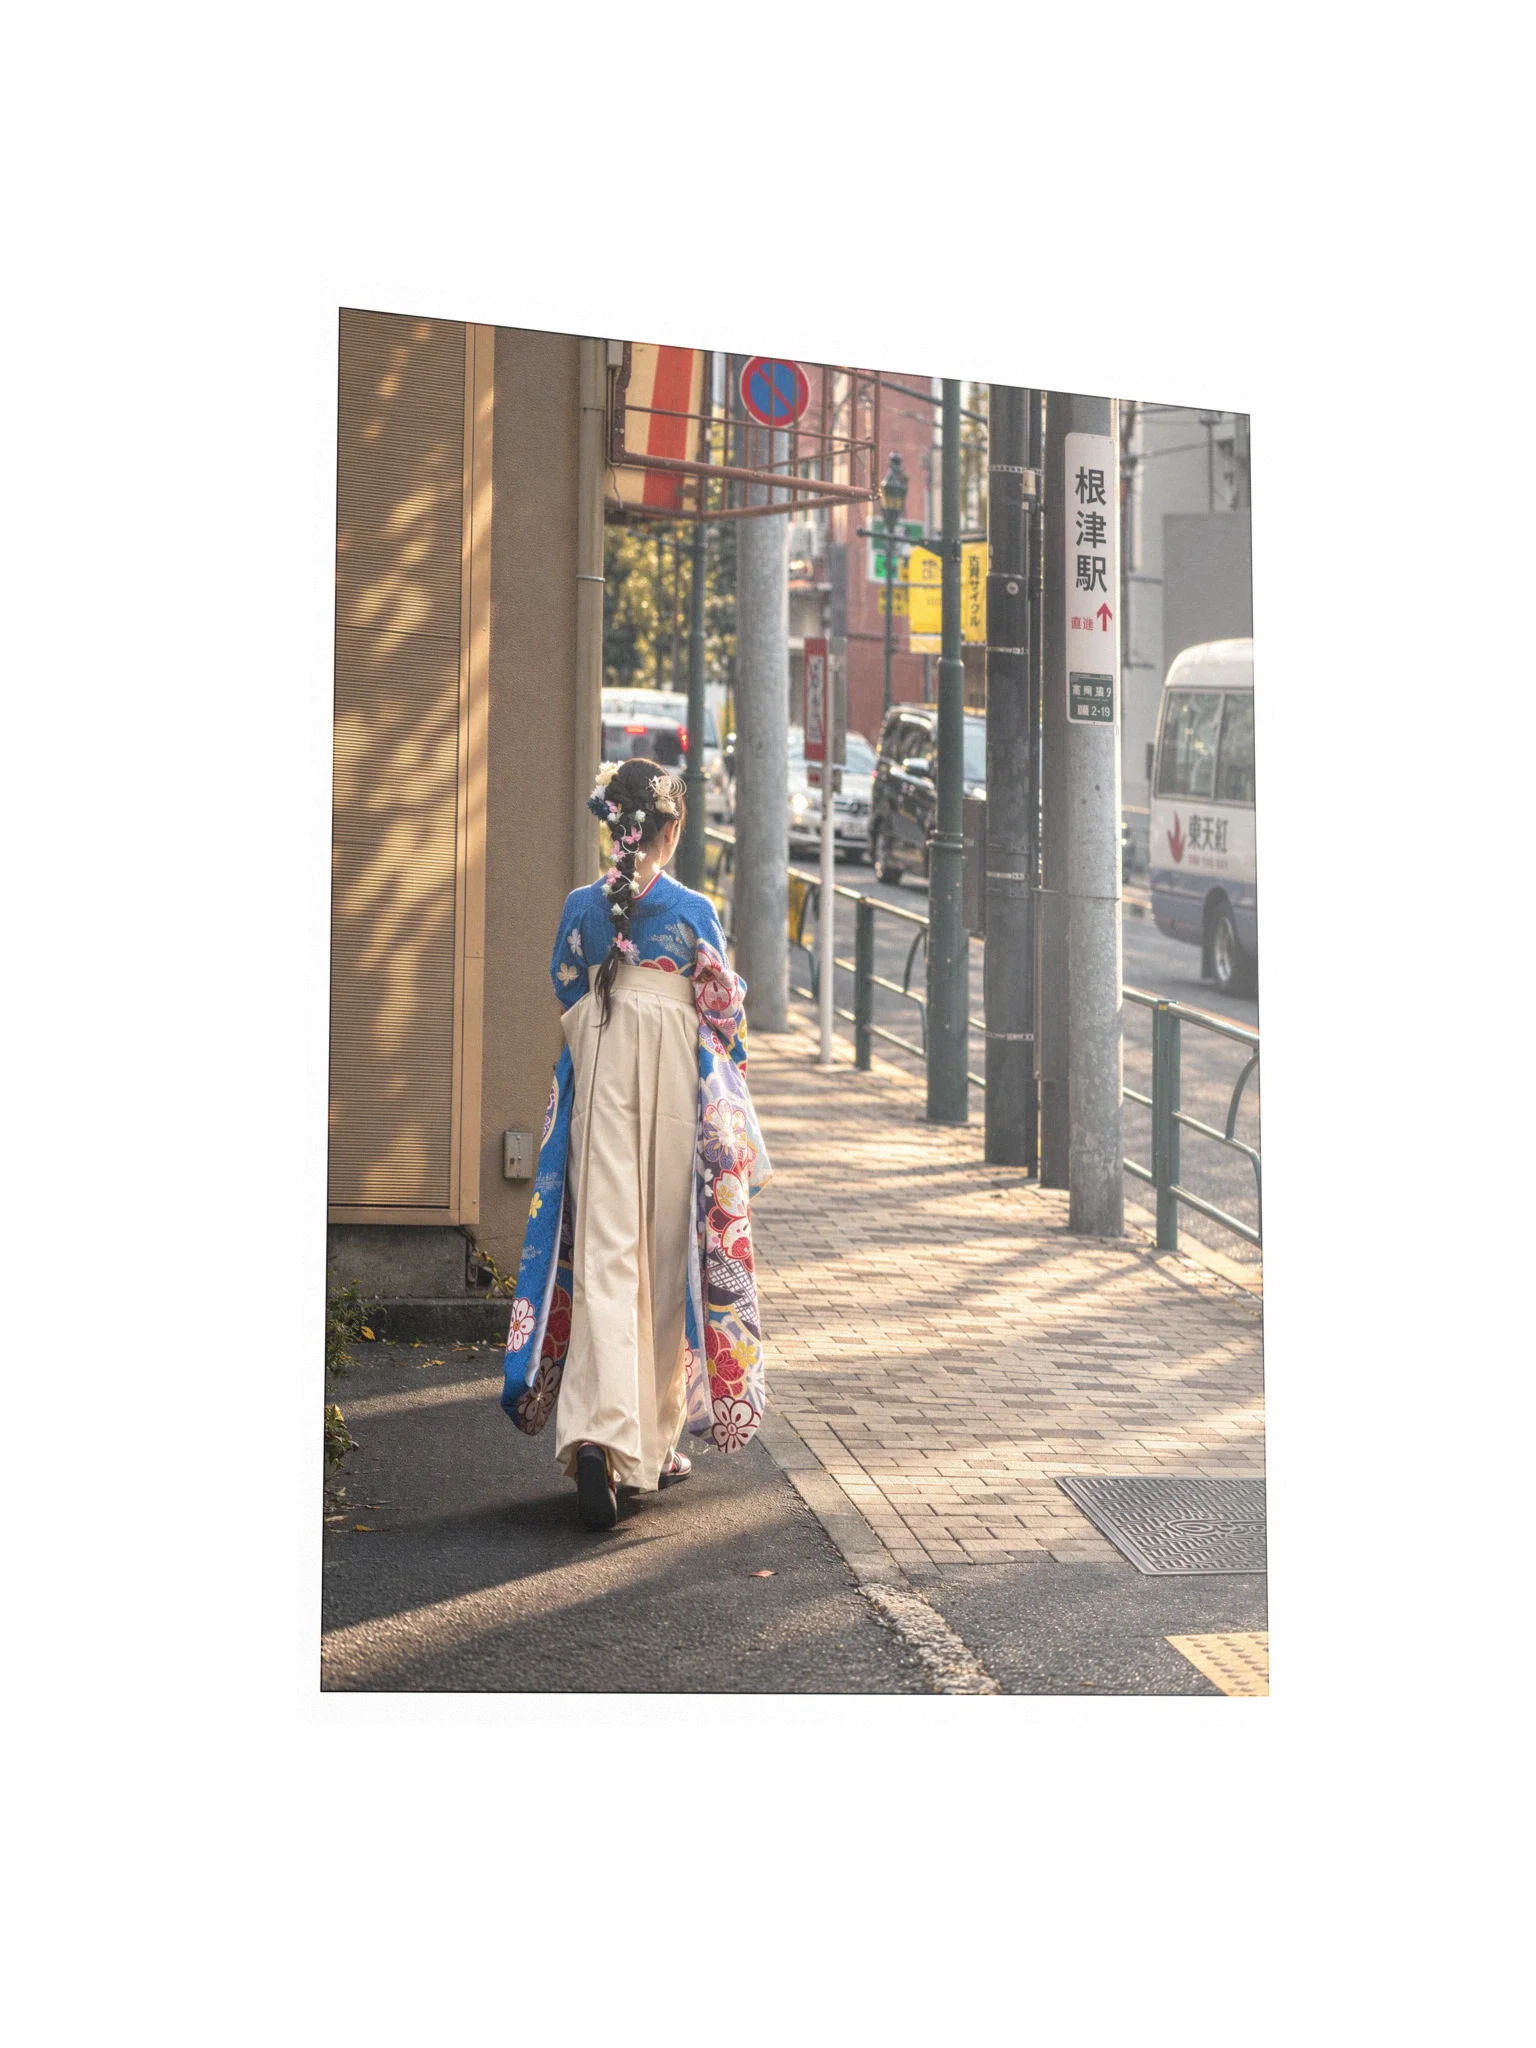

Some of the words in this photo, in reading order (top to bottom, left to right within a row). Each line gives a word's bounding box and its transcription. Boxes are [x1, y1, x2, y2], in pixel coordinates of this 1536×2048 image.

[1075, 466, 1108, 593] 根津駅
[1071, 616, 1094, 631] 直進
[1187, 814, 1229, 855] 東天紅
